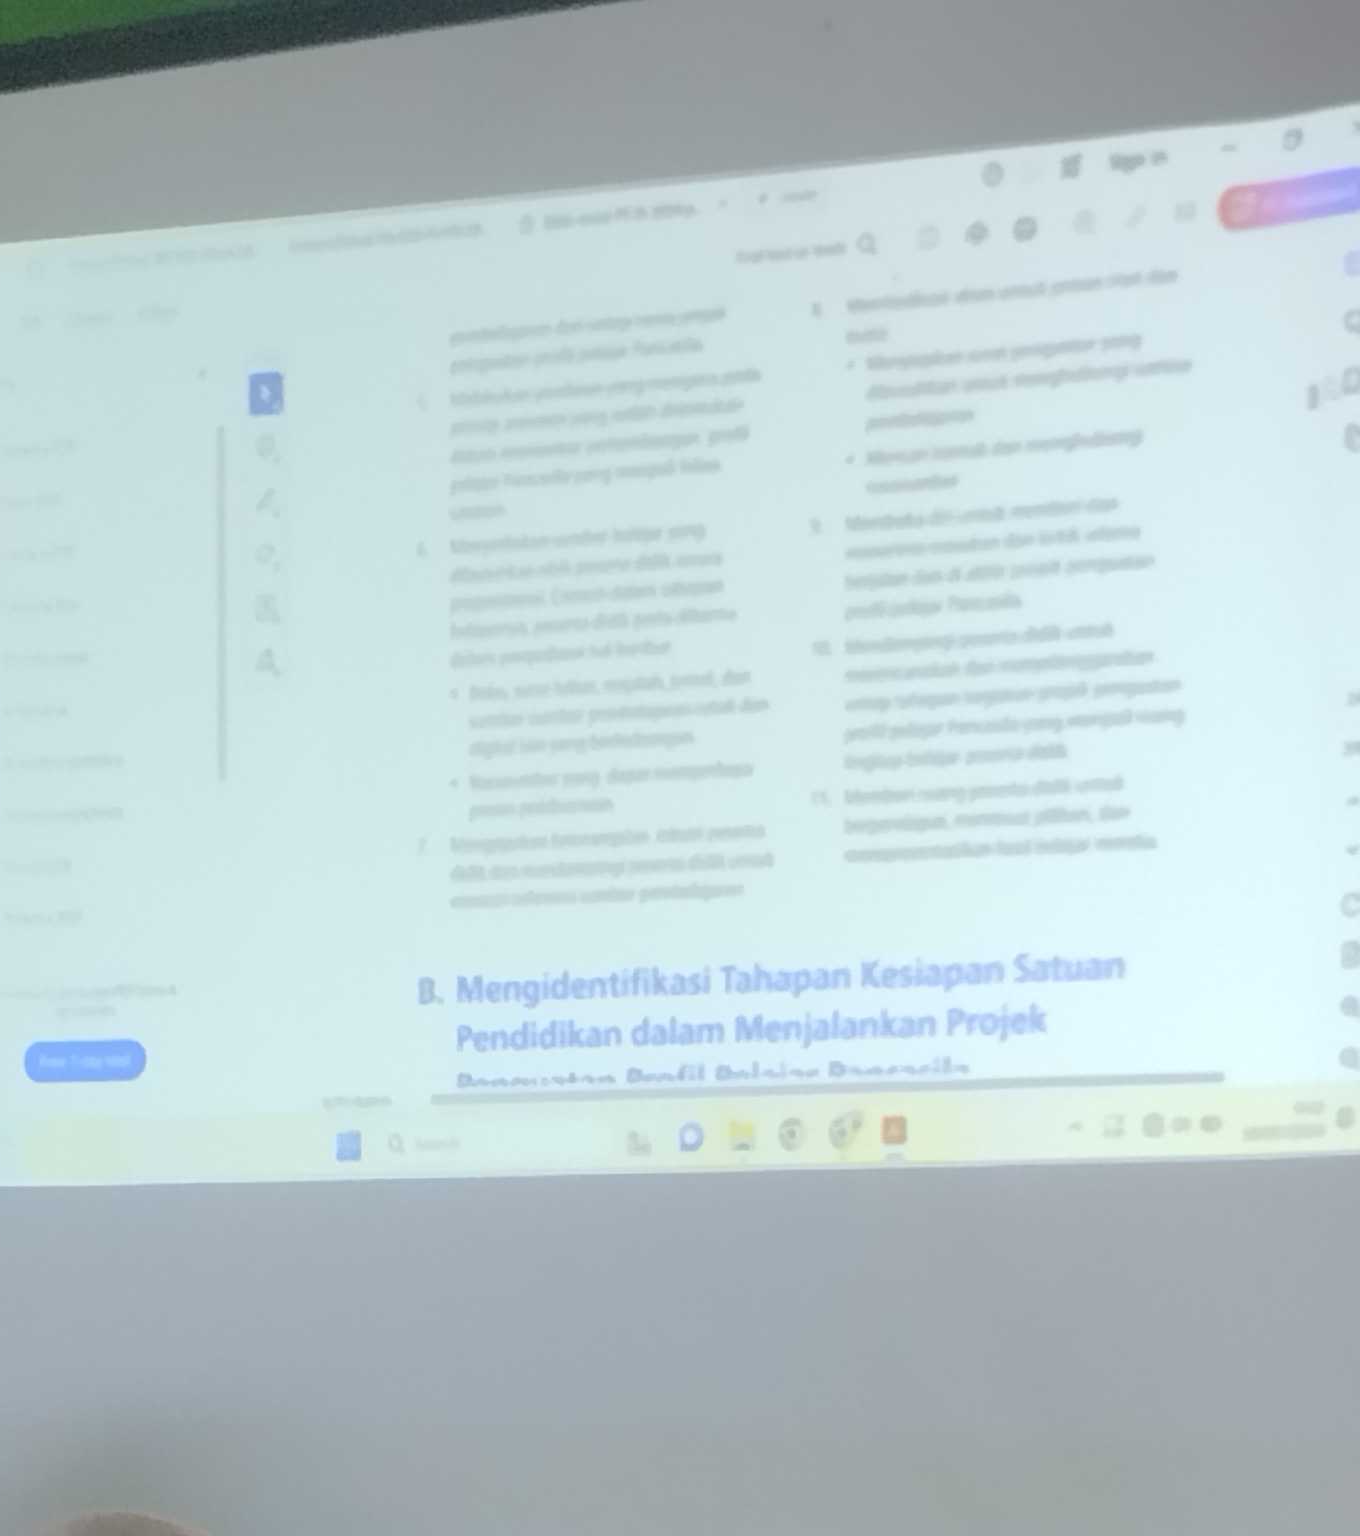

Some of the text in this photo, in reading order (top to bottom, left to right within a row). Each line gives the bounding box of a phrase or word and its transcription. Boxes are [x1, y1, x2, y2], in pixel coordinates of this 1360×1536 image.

[417, 951, 1127, 1009] B. Mengidentifikasi Tahapan Kesiapan Satuan
[455, 1001, 1049, 1053] Pendidikan dalam Menjalankan Projek
